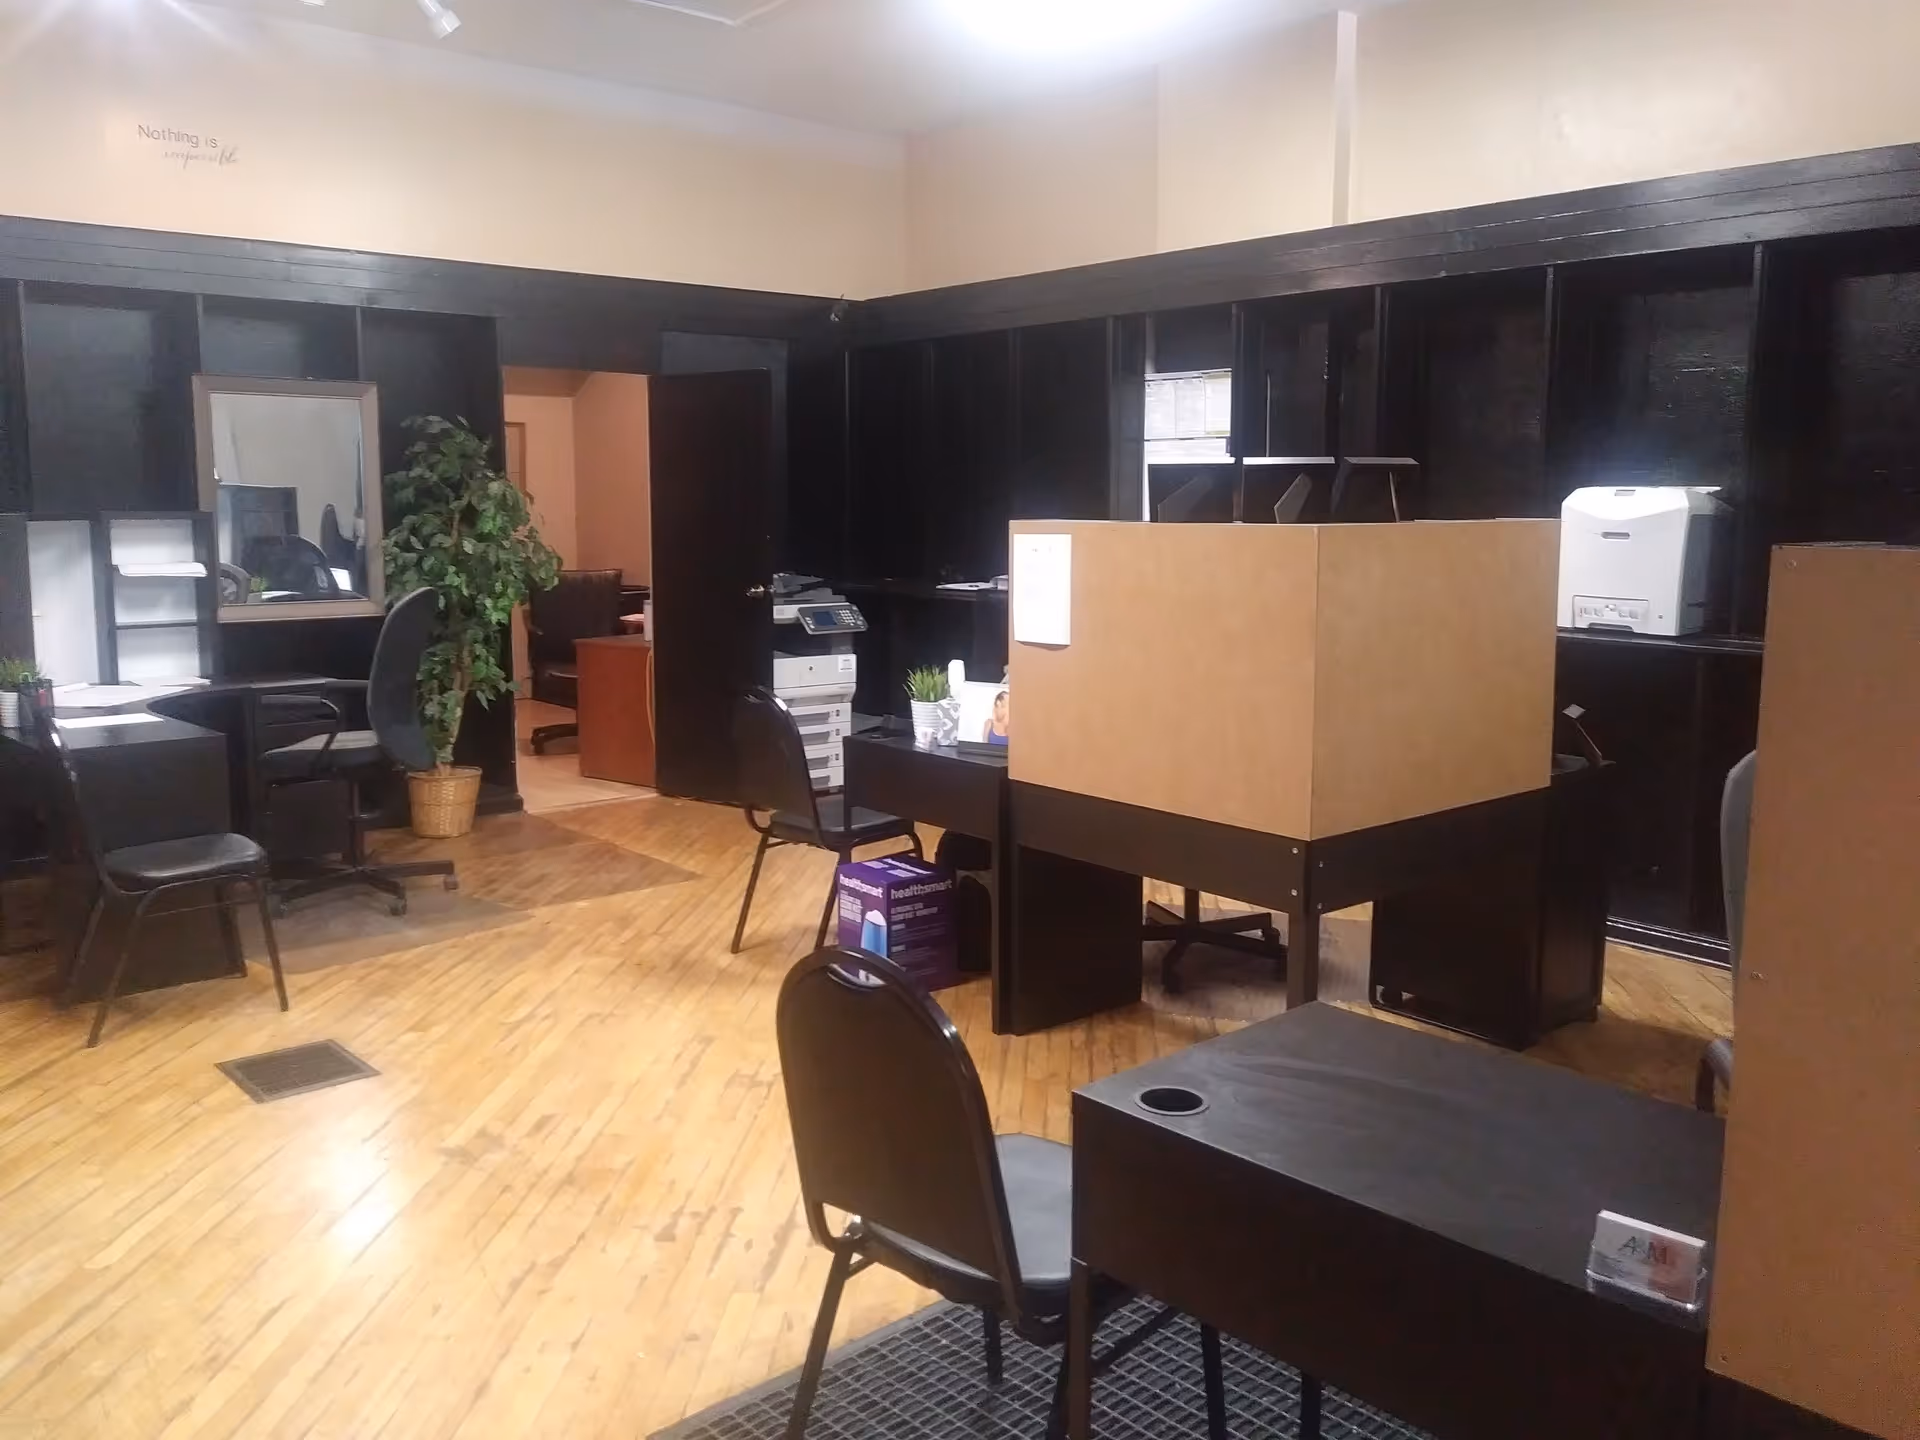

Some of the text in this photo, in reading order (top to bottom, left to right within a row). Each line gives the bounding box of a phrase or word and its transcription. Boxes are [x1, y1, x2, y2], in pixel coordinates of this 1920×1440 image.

[138, 124, 218, 148] Nothing is
[891, 879, 953, 899] healthsmart
